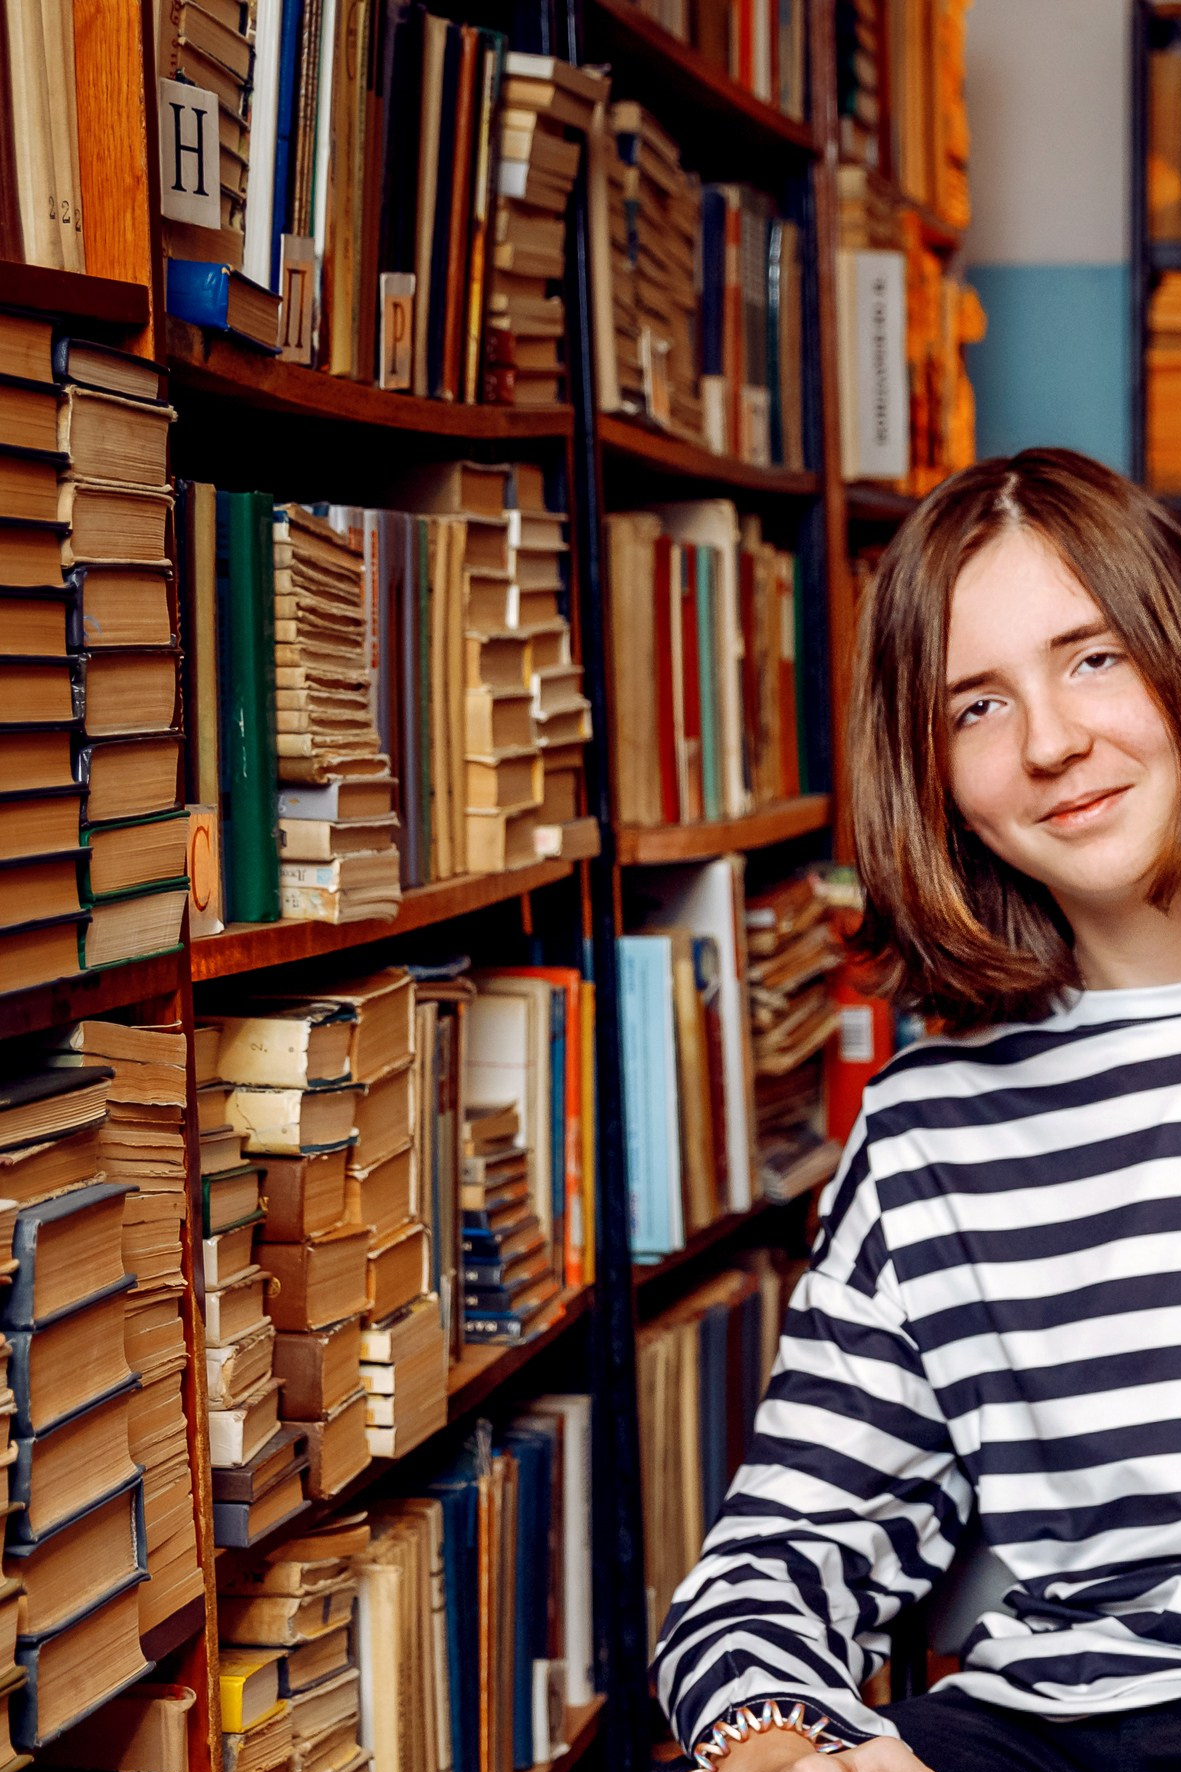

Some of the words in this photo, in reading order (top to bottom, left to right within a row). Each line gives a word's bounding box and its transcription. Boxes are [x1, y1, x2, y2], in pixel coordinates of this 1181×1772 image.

[169, 102, 210, 197] Н
[49, 195, 56, 220] 2
[62, 200, 71, 224] 2
[283, 268, 307, 349] П
[390, 302, 406, 375] Р
[190, 825, 211, 912] С
